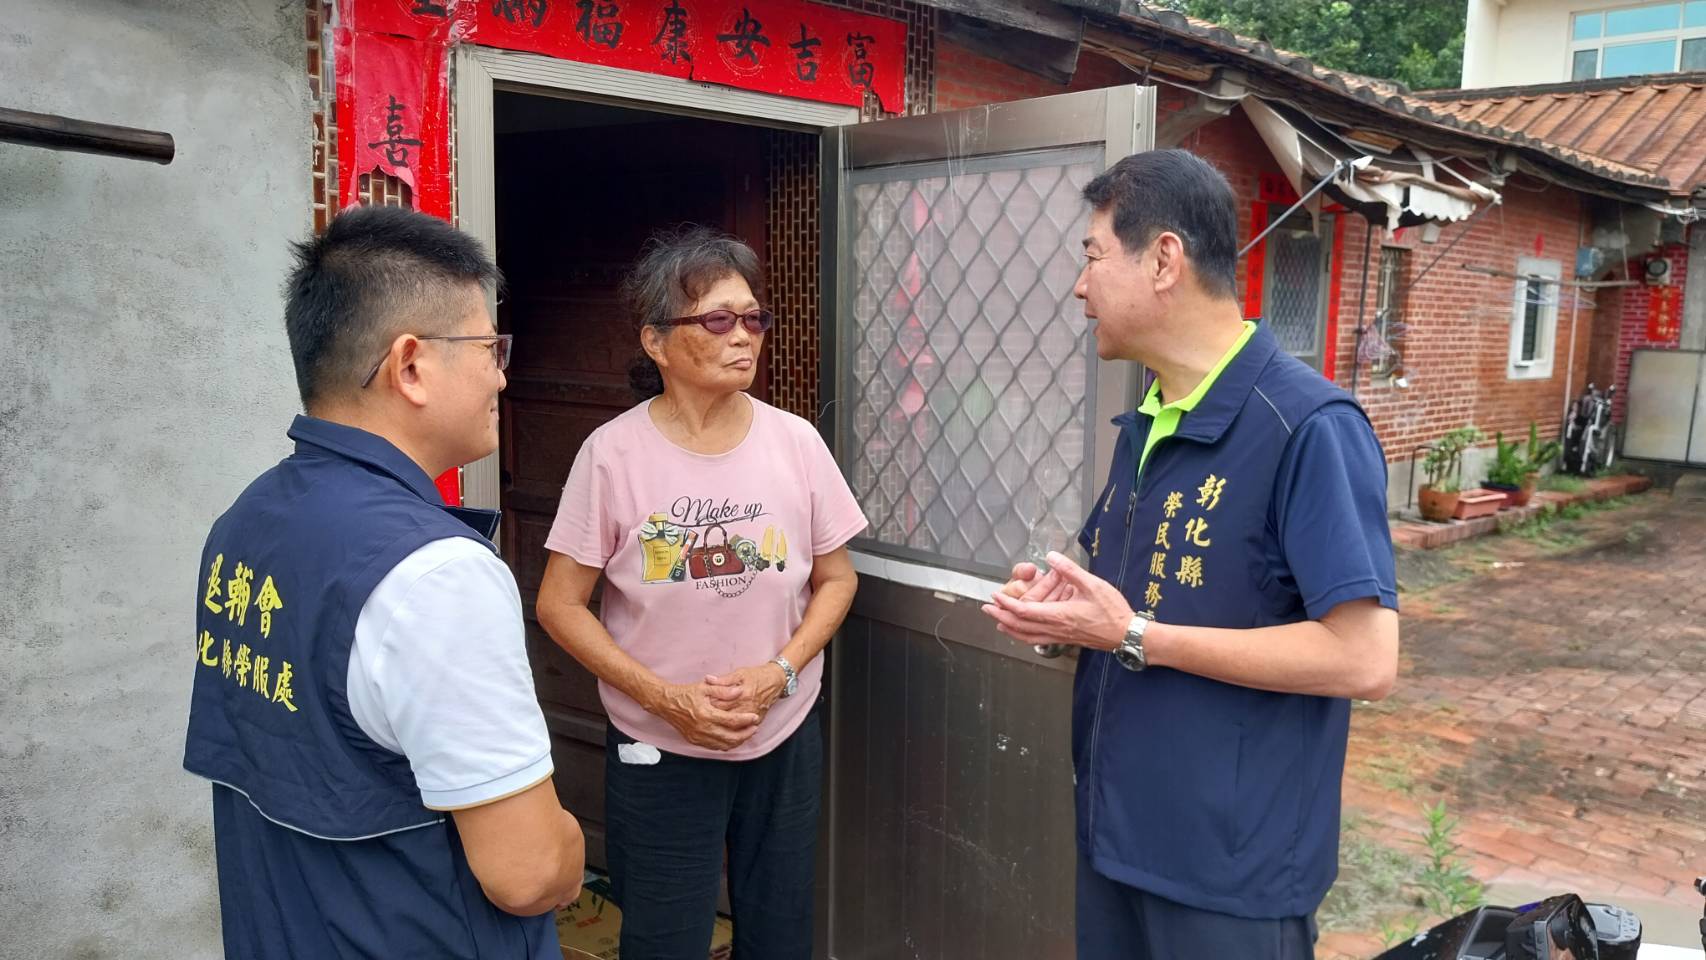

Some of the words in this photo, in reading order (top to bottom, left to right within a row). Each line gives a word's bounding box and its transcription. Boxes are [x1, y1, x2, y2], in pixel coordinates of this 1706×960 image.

[368, 95, 423, 168] 喜
[671, 496, 740, 526] Make
[744, 501, 763, 522] up
[1176, 474, 1226, 588] 彰化縣
[696, 576, 747, 590] FASHION
